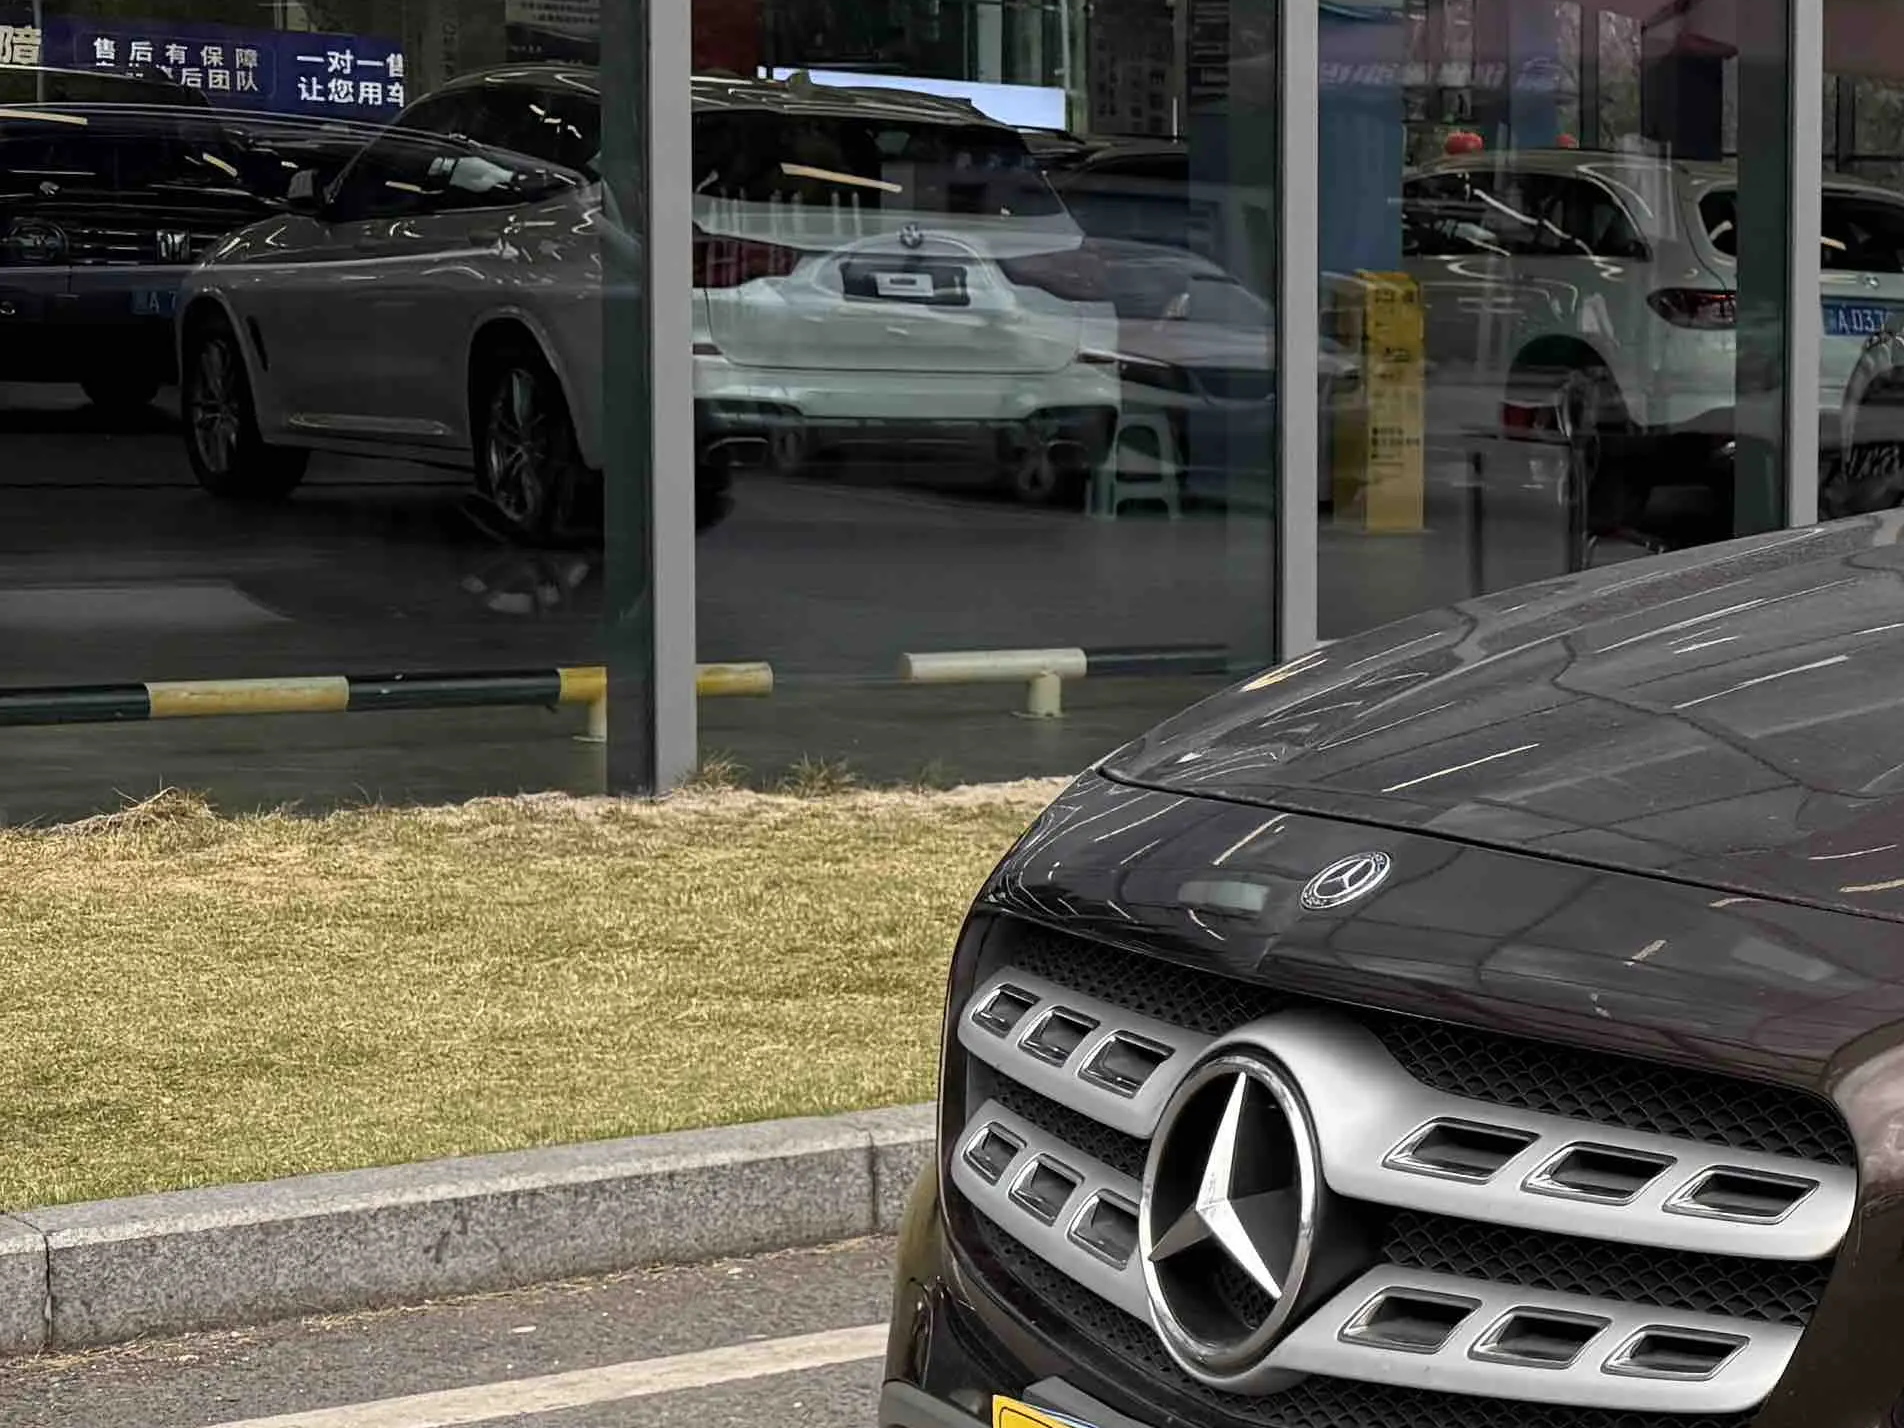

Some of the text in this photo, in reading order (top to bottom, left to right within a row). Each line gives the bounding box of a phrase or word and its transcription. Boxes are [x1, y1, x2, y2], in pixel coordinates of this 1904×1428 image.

[92, 37, 260, 70] 售后有保障
